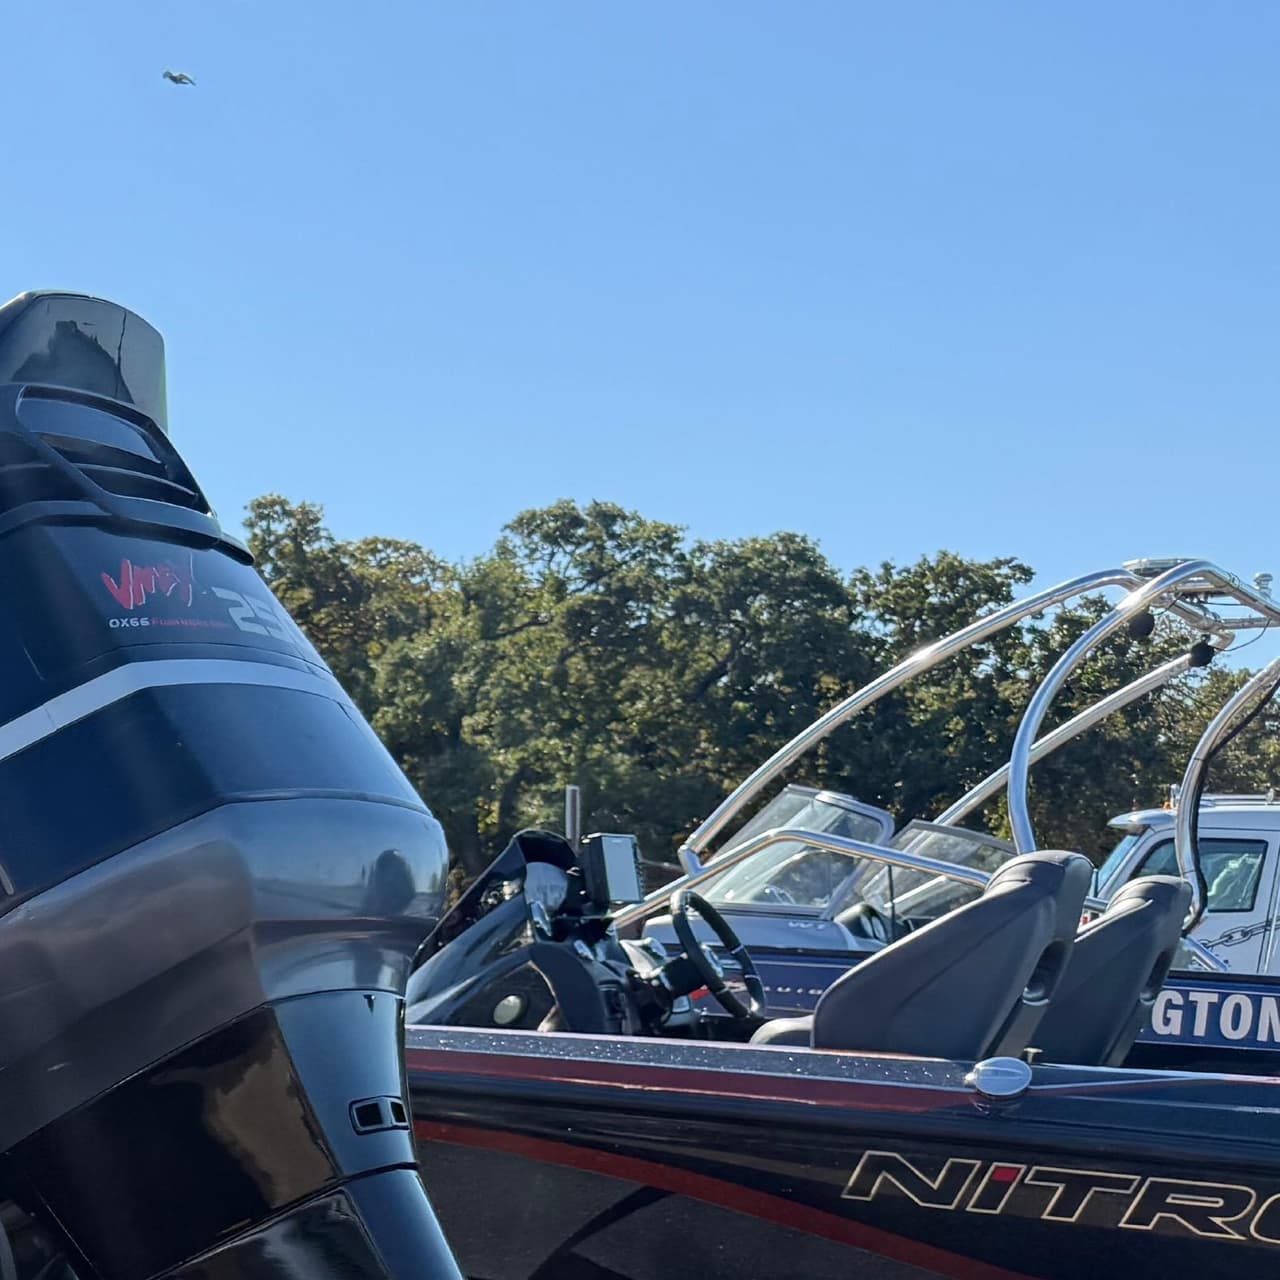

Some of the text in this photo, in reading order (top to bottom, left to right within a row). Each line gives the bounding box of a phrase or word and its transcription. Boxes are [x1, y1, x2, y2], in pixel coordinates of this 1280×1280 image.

[108, 616, 150, 629] OX66
[1147, 989, 1280, 1043] GTON
[841, 1150, 1280, 1244] NITR
